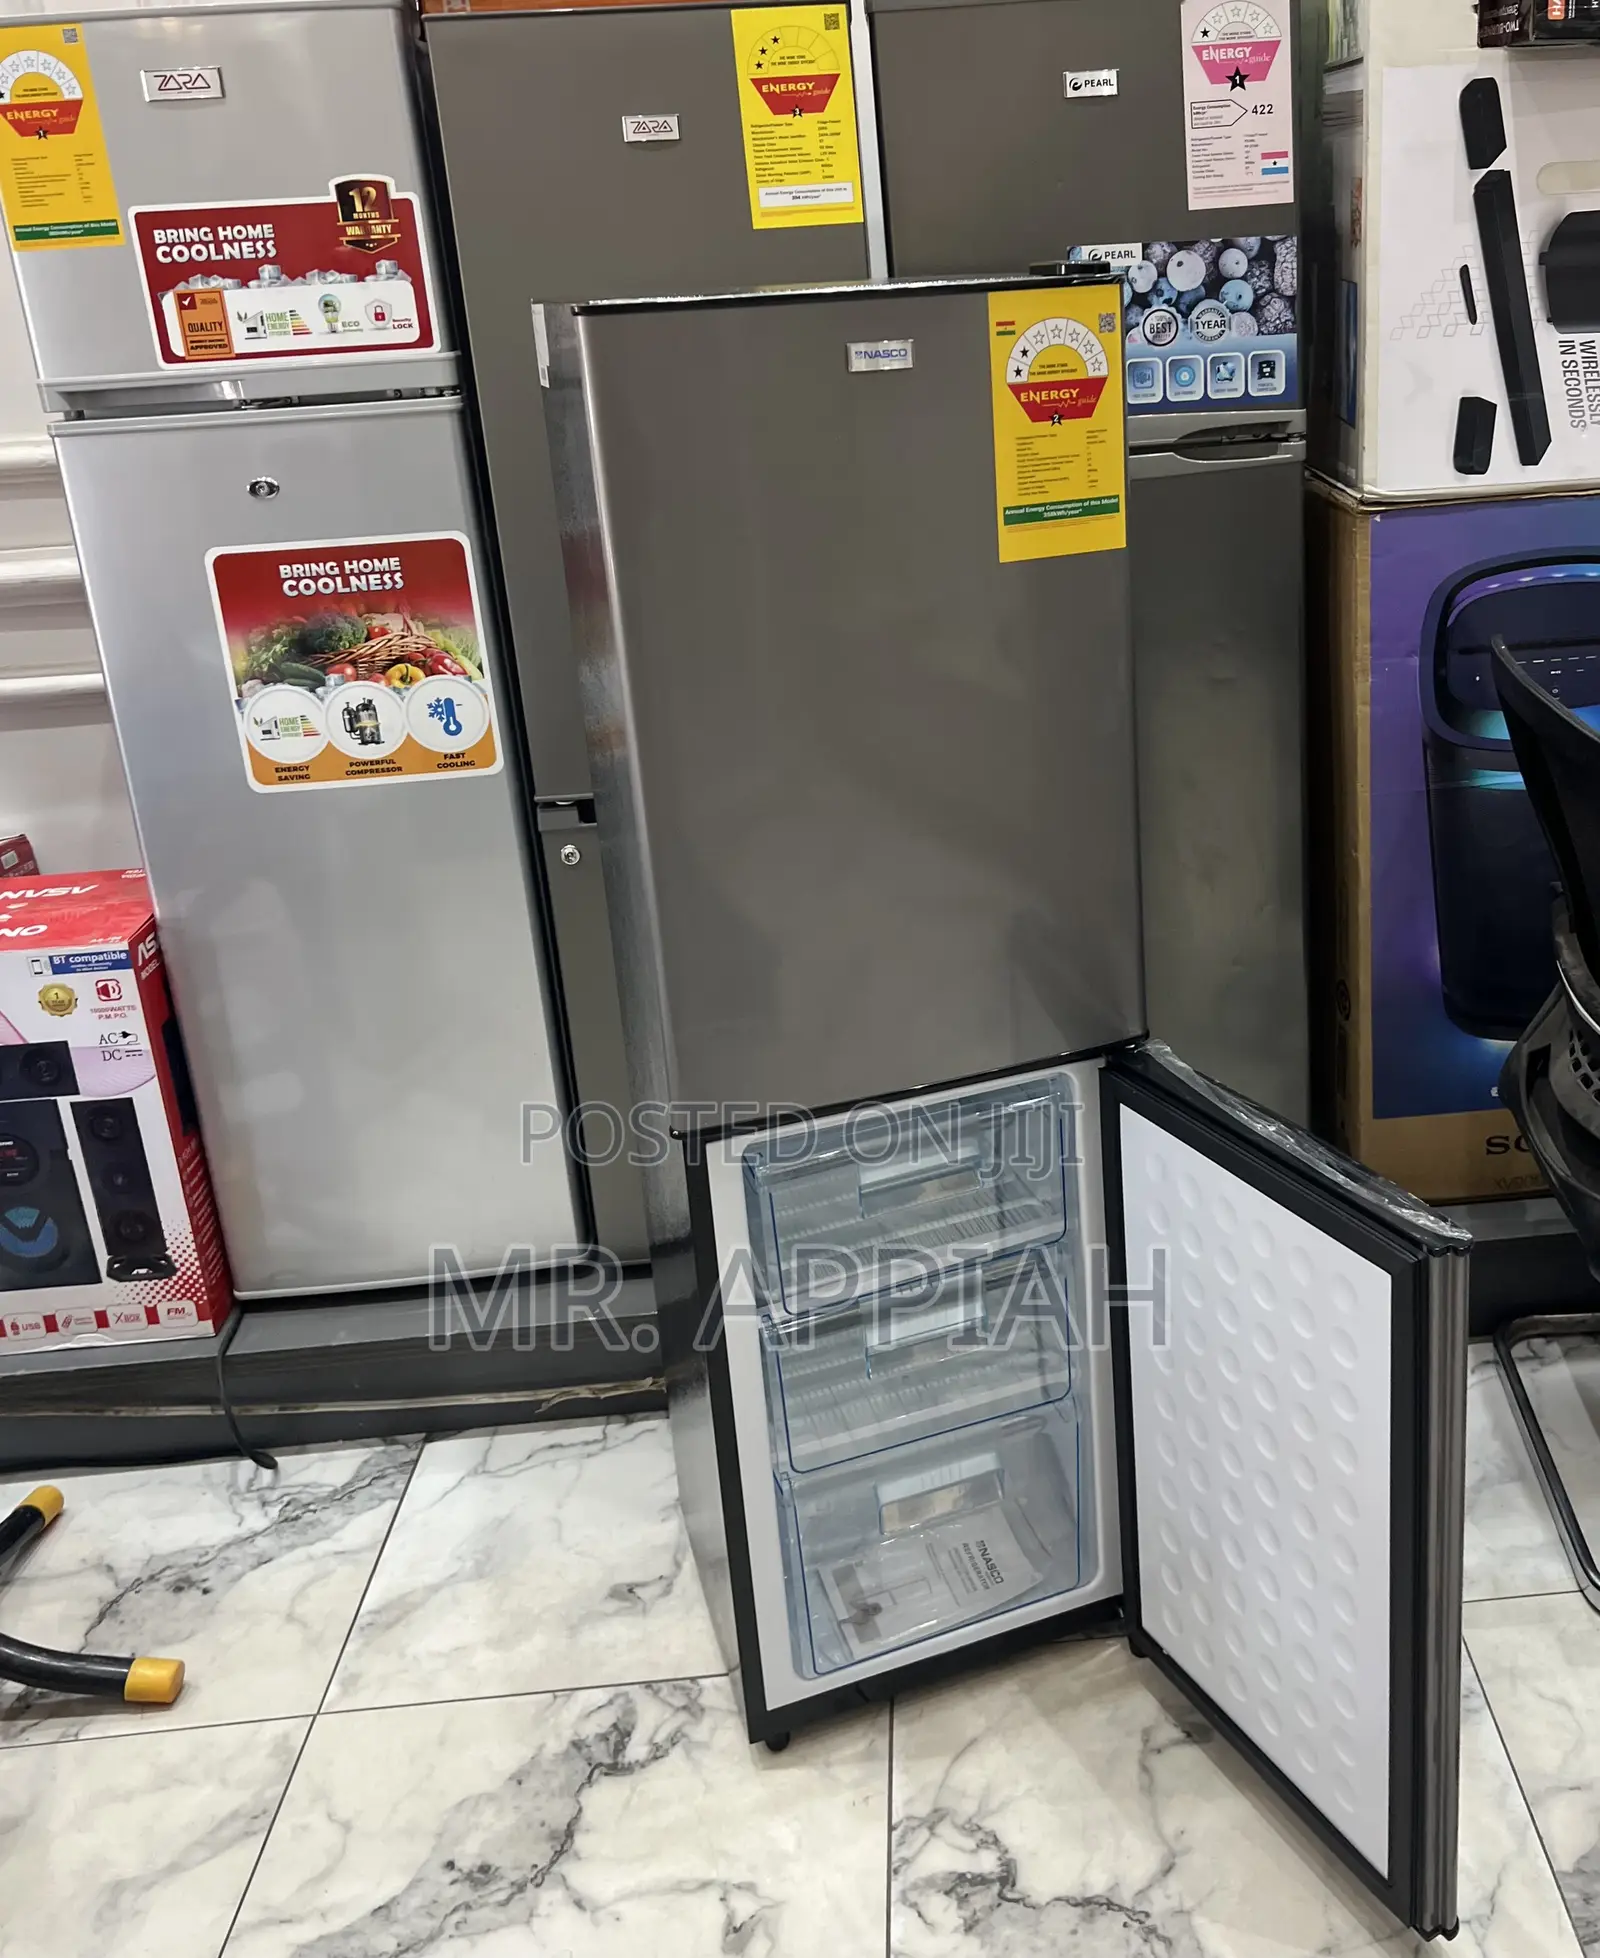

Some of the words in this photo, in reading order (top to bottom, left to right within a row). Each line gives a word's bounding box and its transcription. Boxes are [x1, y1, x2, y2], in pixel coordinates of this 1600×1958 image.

[1202, 46, 1253, 64] ENERGY
[153, 73, 212, 91] ZARA
[1084, 78, 1115, 89] PEARL
[1234, 75, 1241, 85] 1
[762, 82, 815, 94] ENERGY
[1251, 103, 1274, 115] 422
[6, 108, 59, 123] ENERGY
[630, 120, 673, 134] ZARA
[348, 186, 378, 213] 12
[153, 225, 214, 245] BRING
[218, 223, 275, 242] HOME
[156, 240, 278, 263] COOLNESS
[1104, 250, 1137, 261] PEARL
[265, 311, 289, 323] HOME
[188, 321, 223, 333] QUALITY
[1149, 322, 1172, 335] BEST
[1195, 321, 1199, 329] 1
[1200, 319, 1227, 330] YEAR
[190, 343, 229, 351] APPROVED
[1558, 340, 1577, 355] IN
[863, 348, 908, 360] NASCO
[1020, 388, 1080, 404] ENERGY
[1053, 414, 1059, 422] 2
[1045, 501, 1082, 512] Consumption
[279, 561, 340, 578] BRING
[344, 557, 401, 574] HOME
[282, 571, 404, 597] COOLNESS
[279, 716, 300, 726] HOME
[443, 752, 466, 761] FAST
[349, 758, 397, 768] POWERFUL
[436, 759, 476, 769] COOLING
[274, 765, 311, 774] ENERGY
[345, 766, 403, 776] COMPRESSOR
[278, 773, 311, 782] SAVING
[53, 956, 67, 965] BT
[69, 951, 127, 964] compatible
[98, 1033, 119, 1045] AC
[102, 1050, 122, 1062] DC
[167, 1307, 186, 1316] FM
[22, 1321, 41, 1331] USB
[961, 1541, 991, 1592] REFRIGERATOR
[978, 1546, 1005, 1585] NASCO
